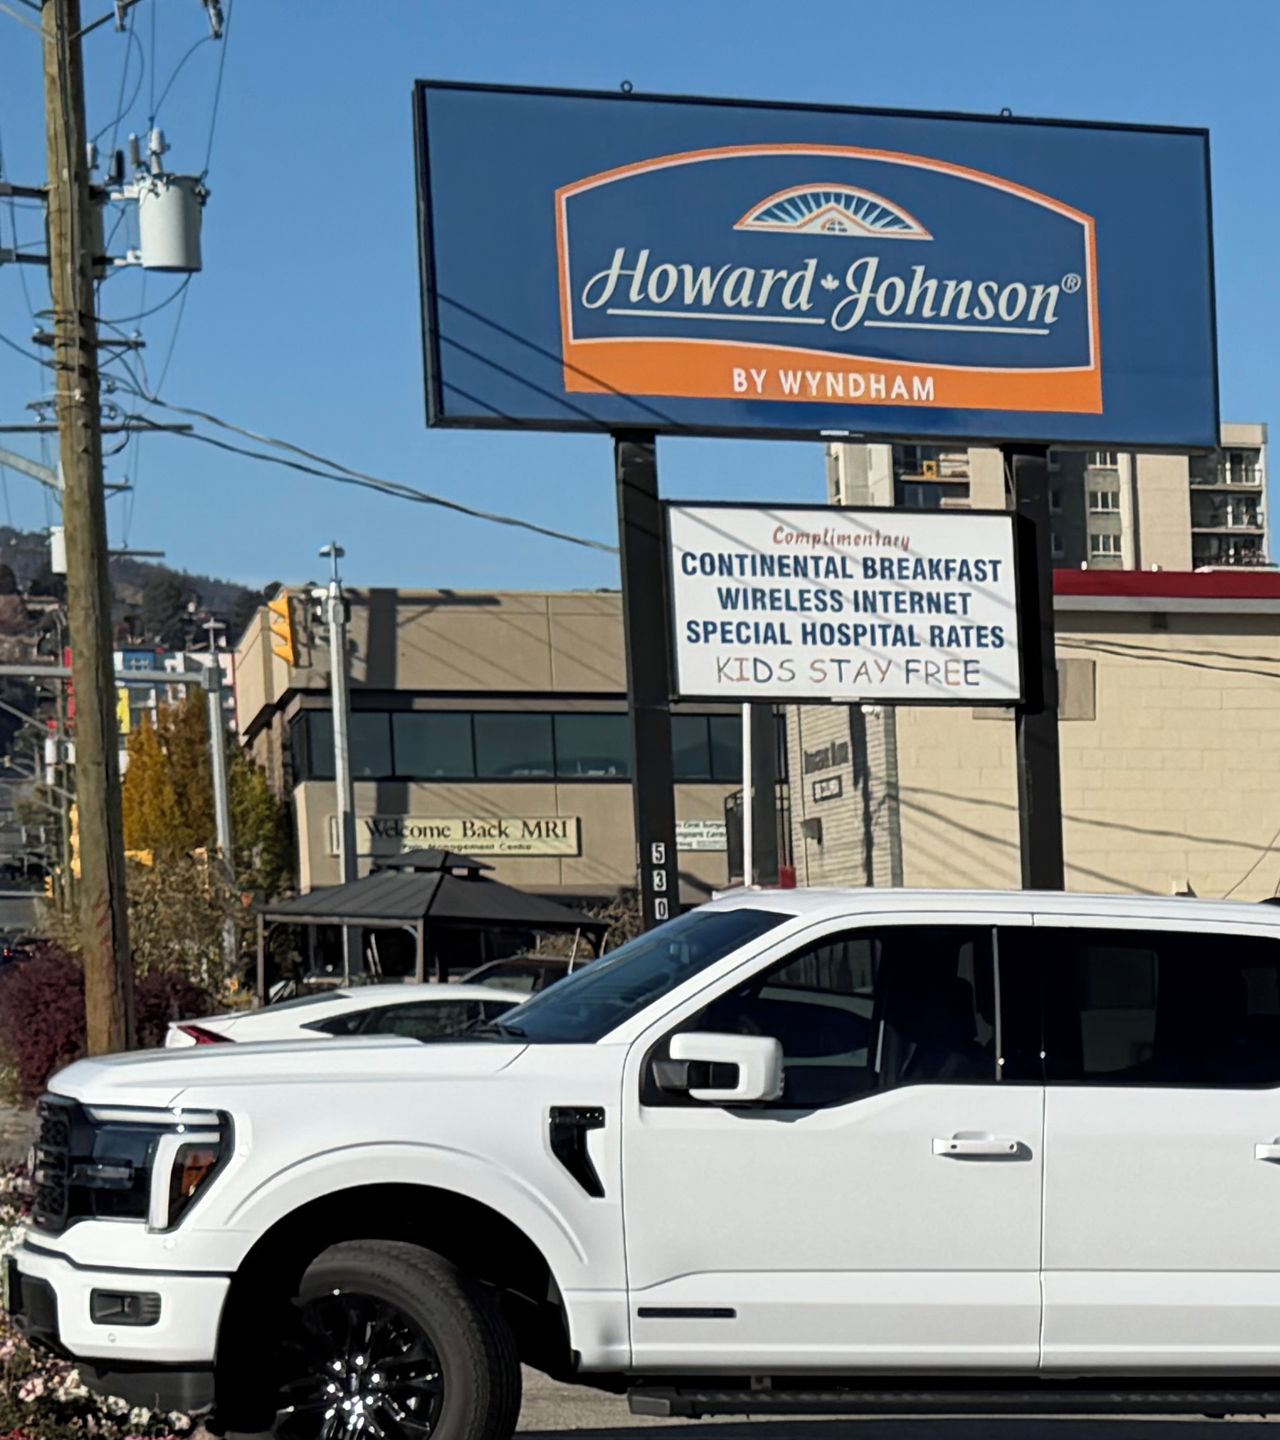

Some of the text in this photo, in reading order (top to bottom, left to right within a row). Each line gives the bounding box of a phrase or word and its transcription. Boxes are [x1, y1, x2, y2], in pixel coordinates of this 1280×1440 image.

[581, 247, 818, 313] Howard
[732, 367, 935, 401] BY WYNDHAM
[772, 525, 910, 551] Complimentary
[681, 551, 1002, 582] CONTINENTAL BREAKFAST
[717, 586, 972, 615] WIRELESS INTERNET
[686, 620, 1005, 648] SPECIAL HOSPITAL RATES
[716, 656, 981, 686] KIDS STAY FREE
[364, 819, 568, 839] Welcome Back MRI
